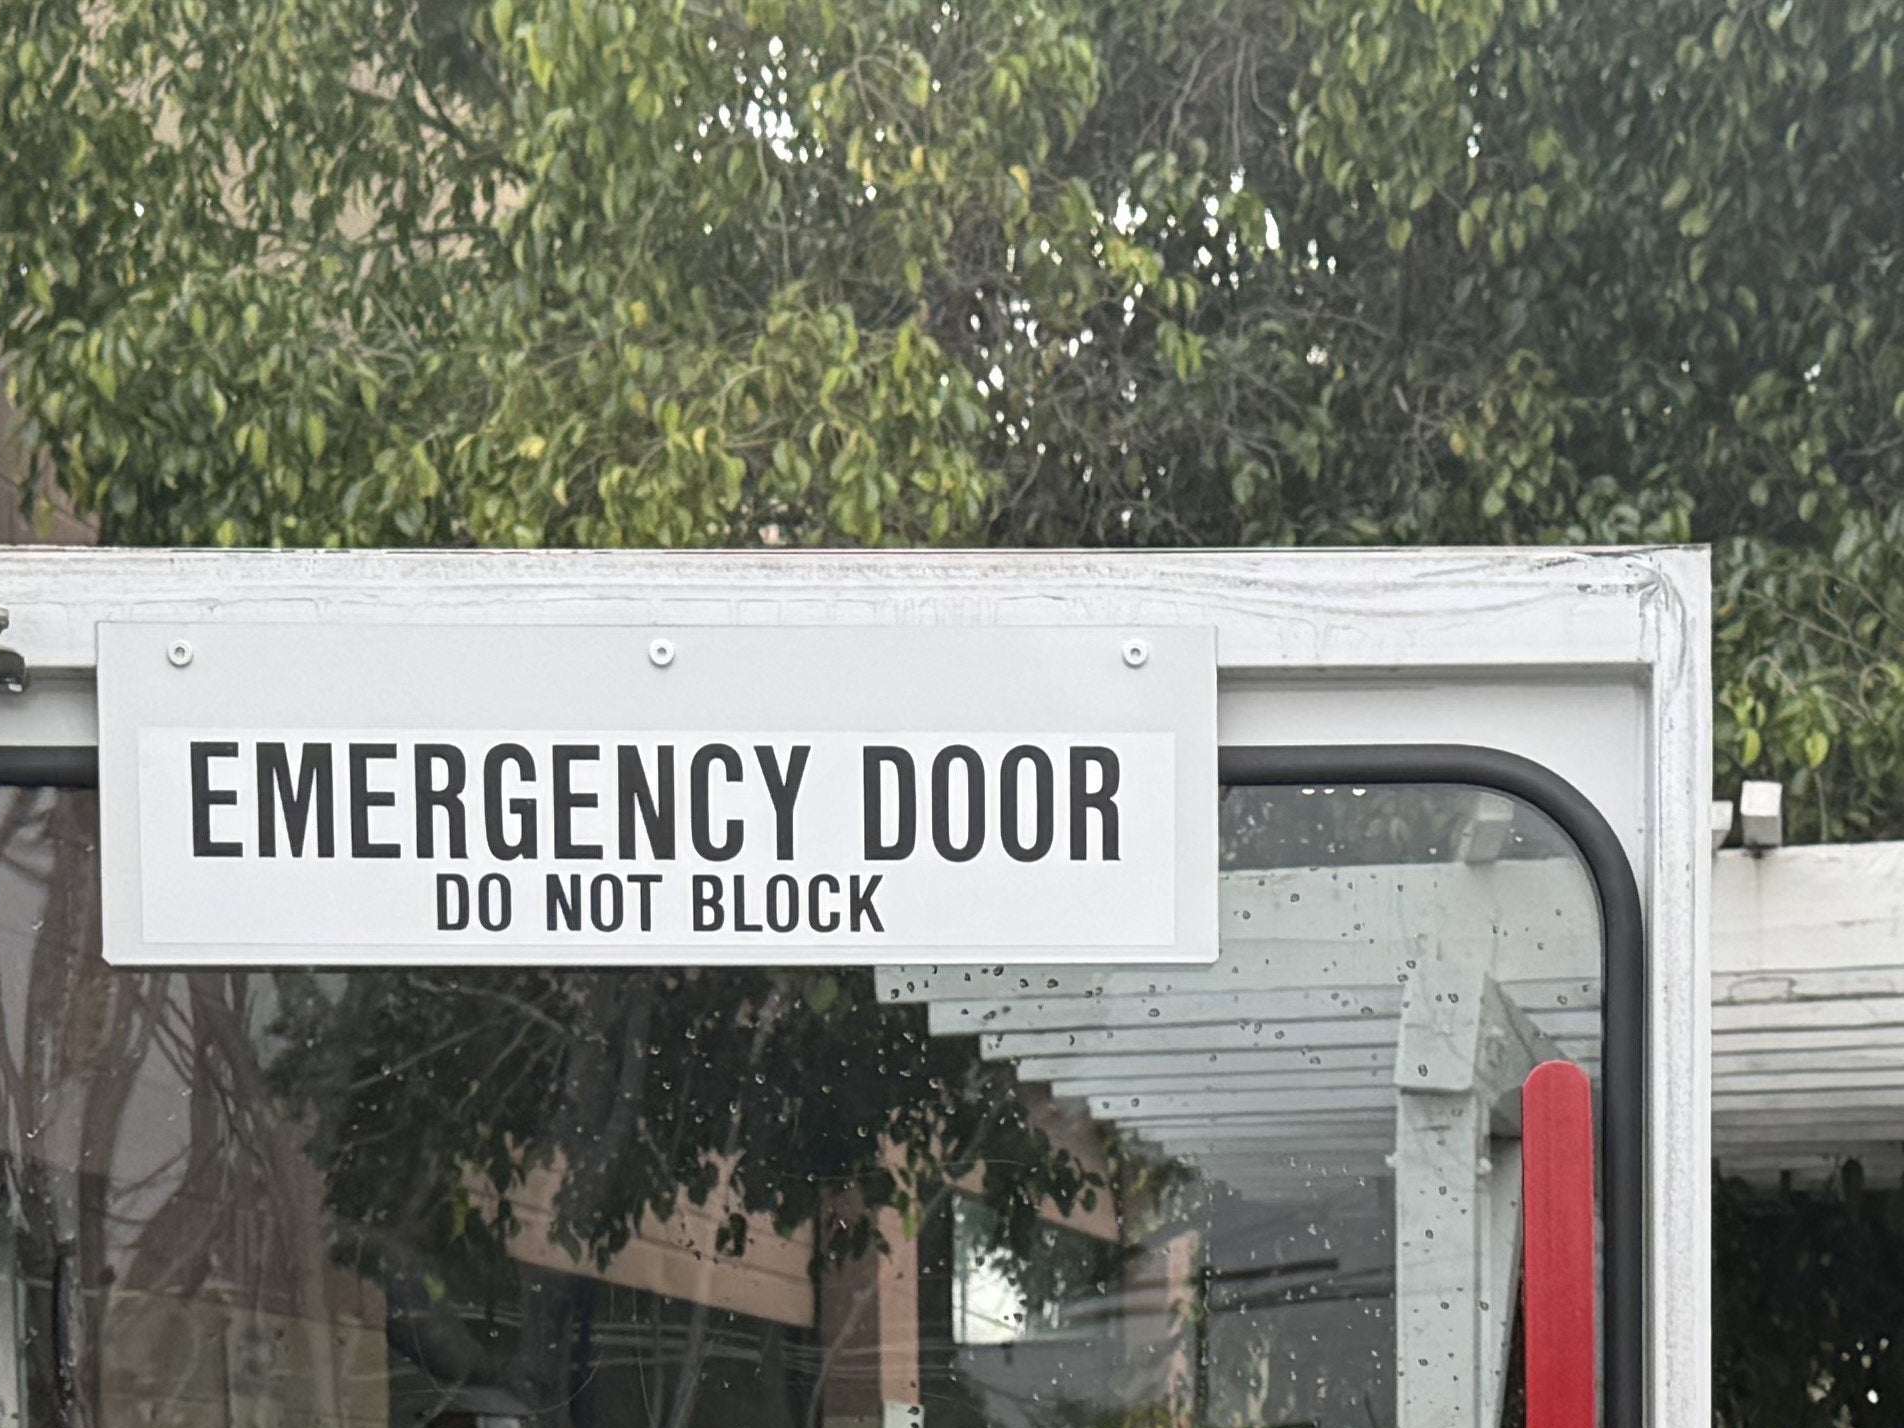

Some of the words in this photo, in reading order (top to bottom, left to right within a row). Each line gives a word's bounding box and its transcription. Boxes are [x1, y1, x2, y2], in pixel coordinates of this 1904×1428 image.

[191, 742, 810, 861] EMERGENCY
[864, 745, 1120, 862] DOOR
[437, 873, 511, 931] DO
[547, 874, 662, 932] NOT
[693, 874, 884, 932] BLOCK
